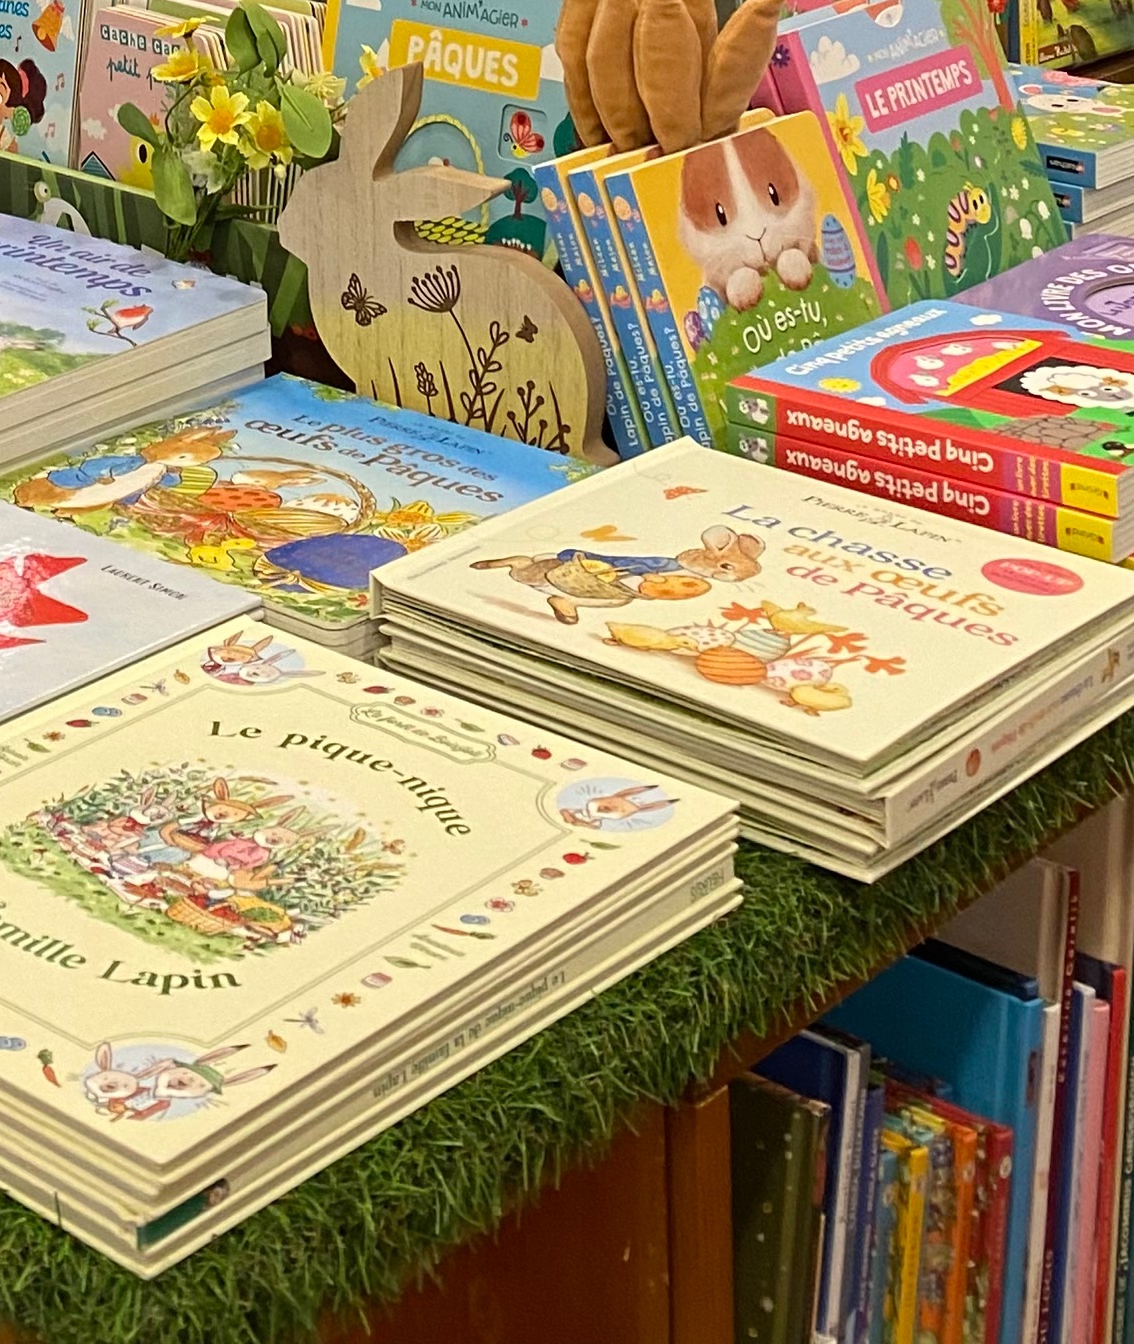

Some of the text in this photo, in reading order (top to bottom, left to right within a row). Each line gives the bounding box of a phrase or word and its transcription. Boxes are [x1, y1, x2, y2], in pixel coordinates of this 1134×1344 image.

[406, 31, 518, 87] PÂQUES
[864, 58, 973, 119] LE PRINTEMPS
[78, 246, 112, 269] air
[114, 260, 152, 279] de
[245, 419, 504, 502] œufs de Pâques
[291, 414, 498, 481] Le plus gros des
[786, 409, 995, 474] Cinq petits agneaux
[723, 504, 953, 581] La chasse
[783, 542, 1005, 617] aux œufs
[786, 564, 1019, 648] de Pâques
[209, 719, 263, 742] Le
[277, 730, 473, 839] pique-nique
[98, 958, 243, 996] Lapin
